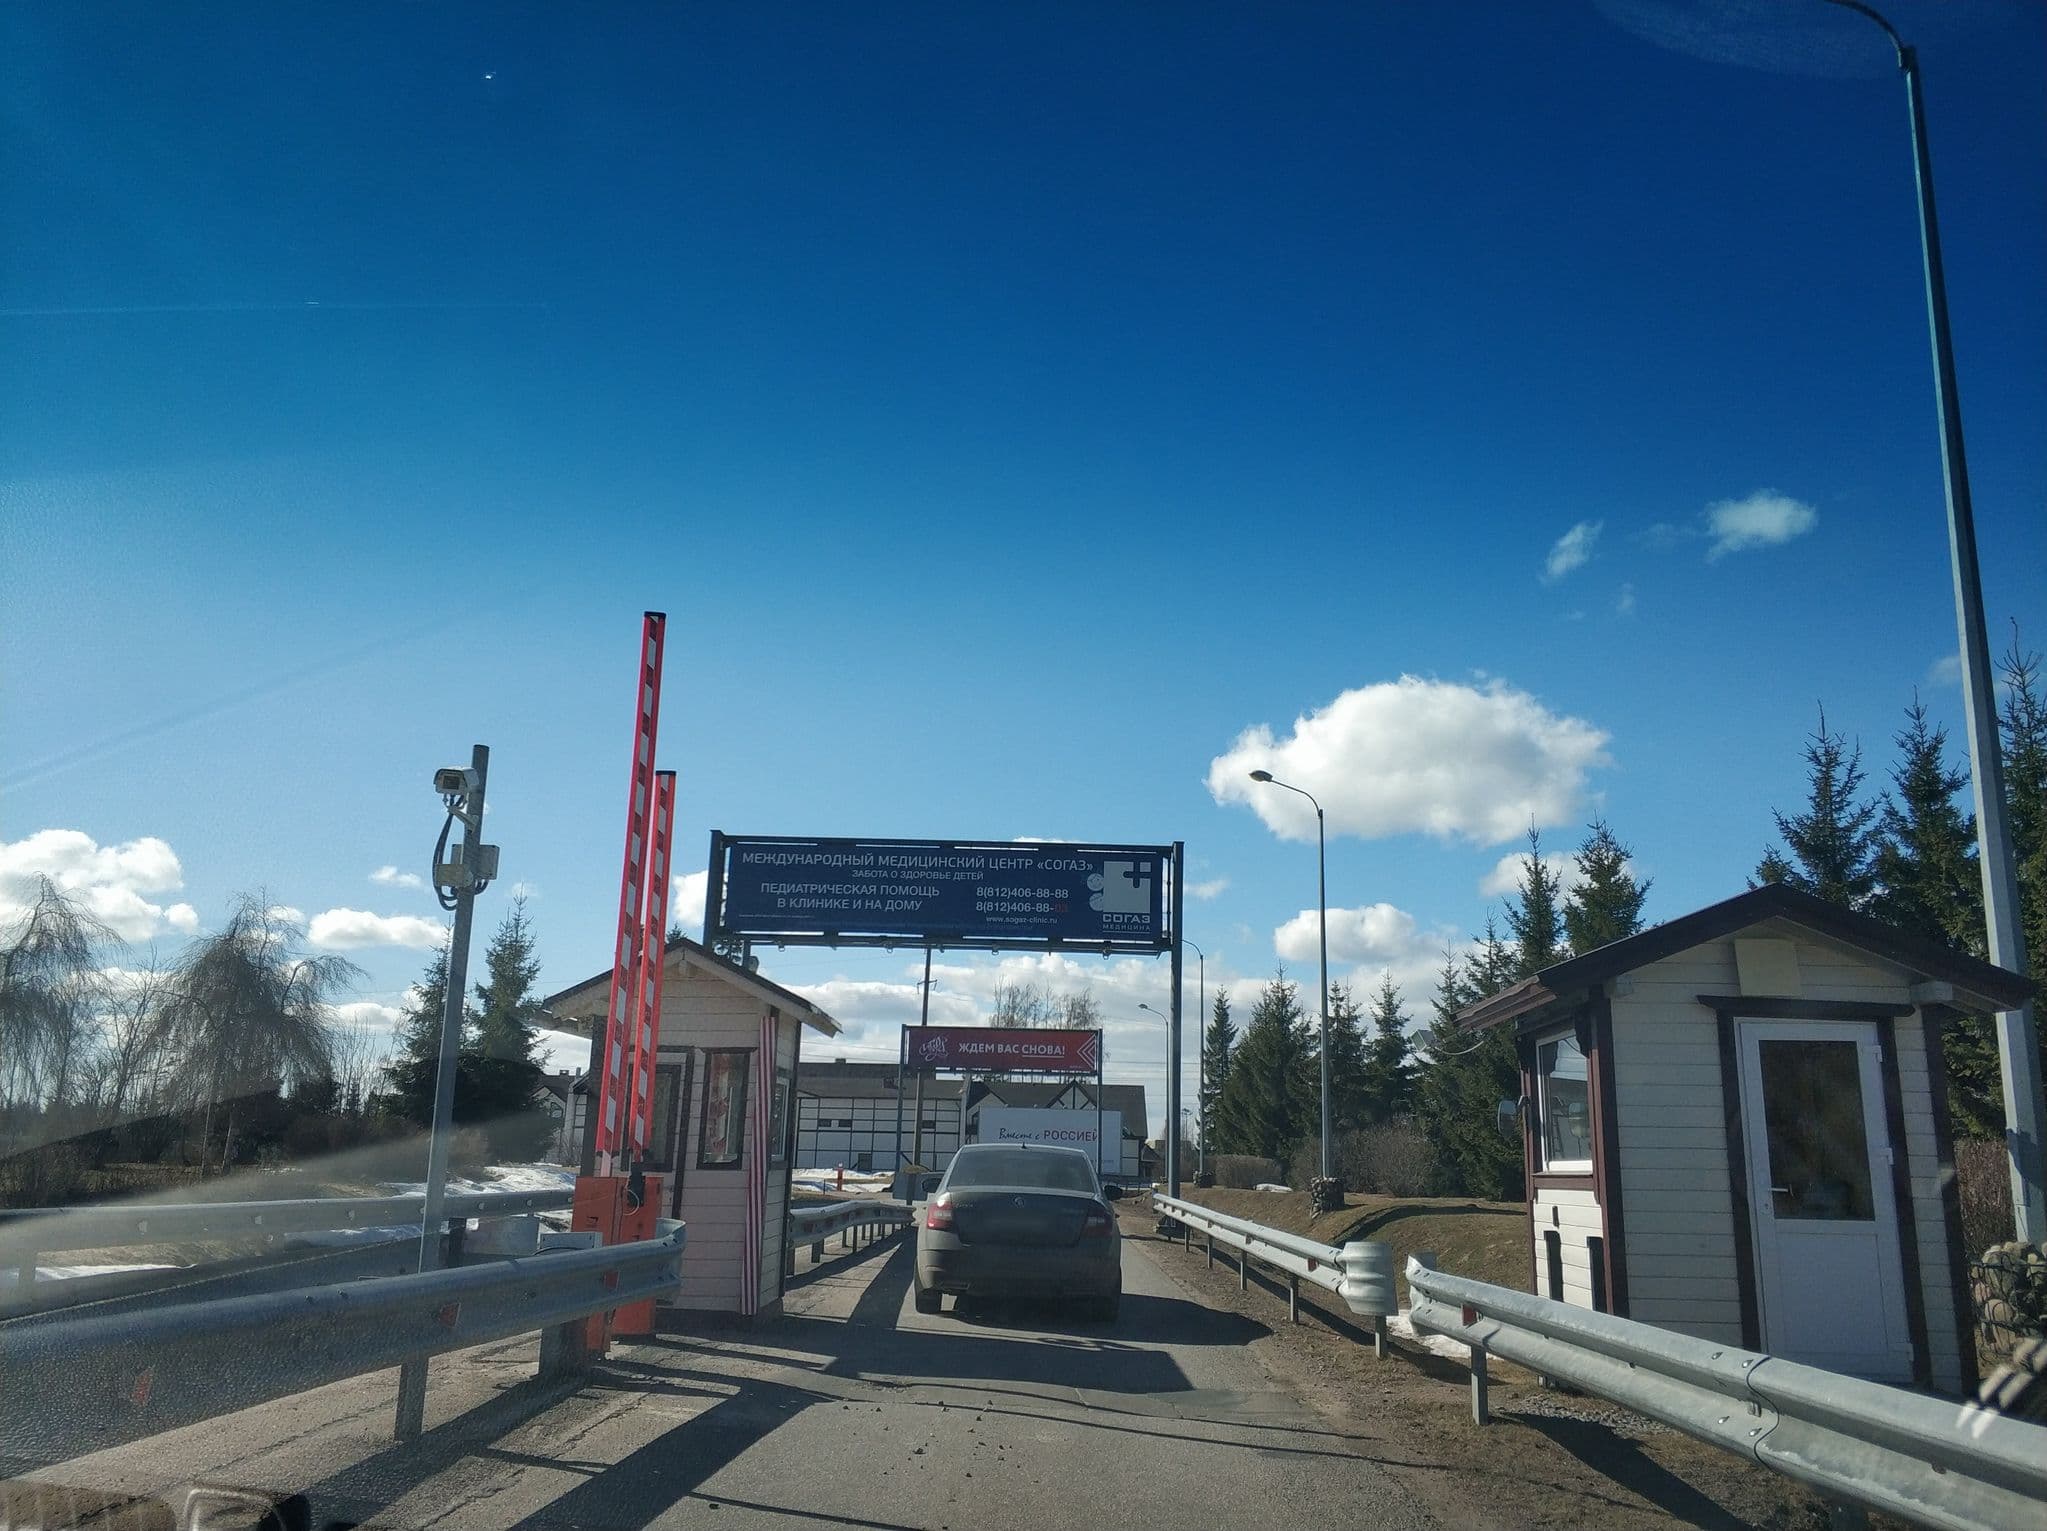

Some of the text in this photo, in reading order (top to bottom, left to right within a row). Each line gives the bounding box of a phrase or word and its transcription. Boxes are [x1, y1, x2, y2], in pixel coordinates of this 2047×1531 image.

[742, 852, 1094, 871] МЕЖДУНАРОДНЫЙ МЕДИЦИНСКИЙ ЦЕНТР «СОГАЗ»
[851, 870, 888, 878] ЗАБОТА
[900, 871, 951, 880] ЗДОРОВЬЕ
[953, 872, 984, 881] ДЕТЕЙ
[761, 883, 940, 897] ПЕДИАТРИЧЕСКАЯ ПОМОЩЬ
[976, 887, 1069, 899] 8(812)406-88-88
[777, 898, 922, 911] В КЛИНИКЕ И НА ДОМУ
[1103, 914, 1151, 923] СОГАЗ
[959, 1042, 1065, 1056] ЖДЕМ ВАС СНОВА!
[999, 1128, 1033, 1140] Вместе
